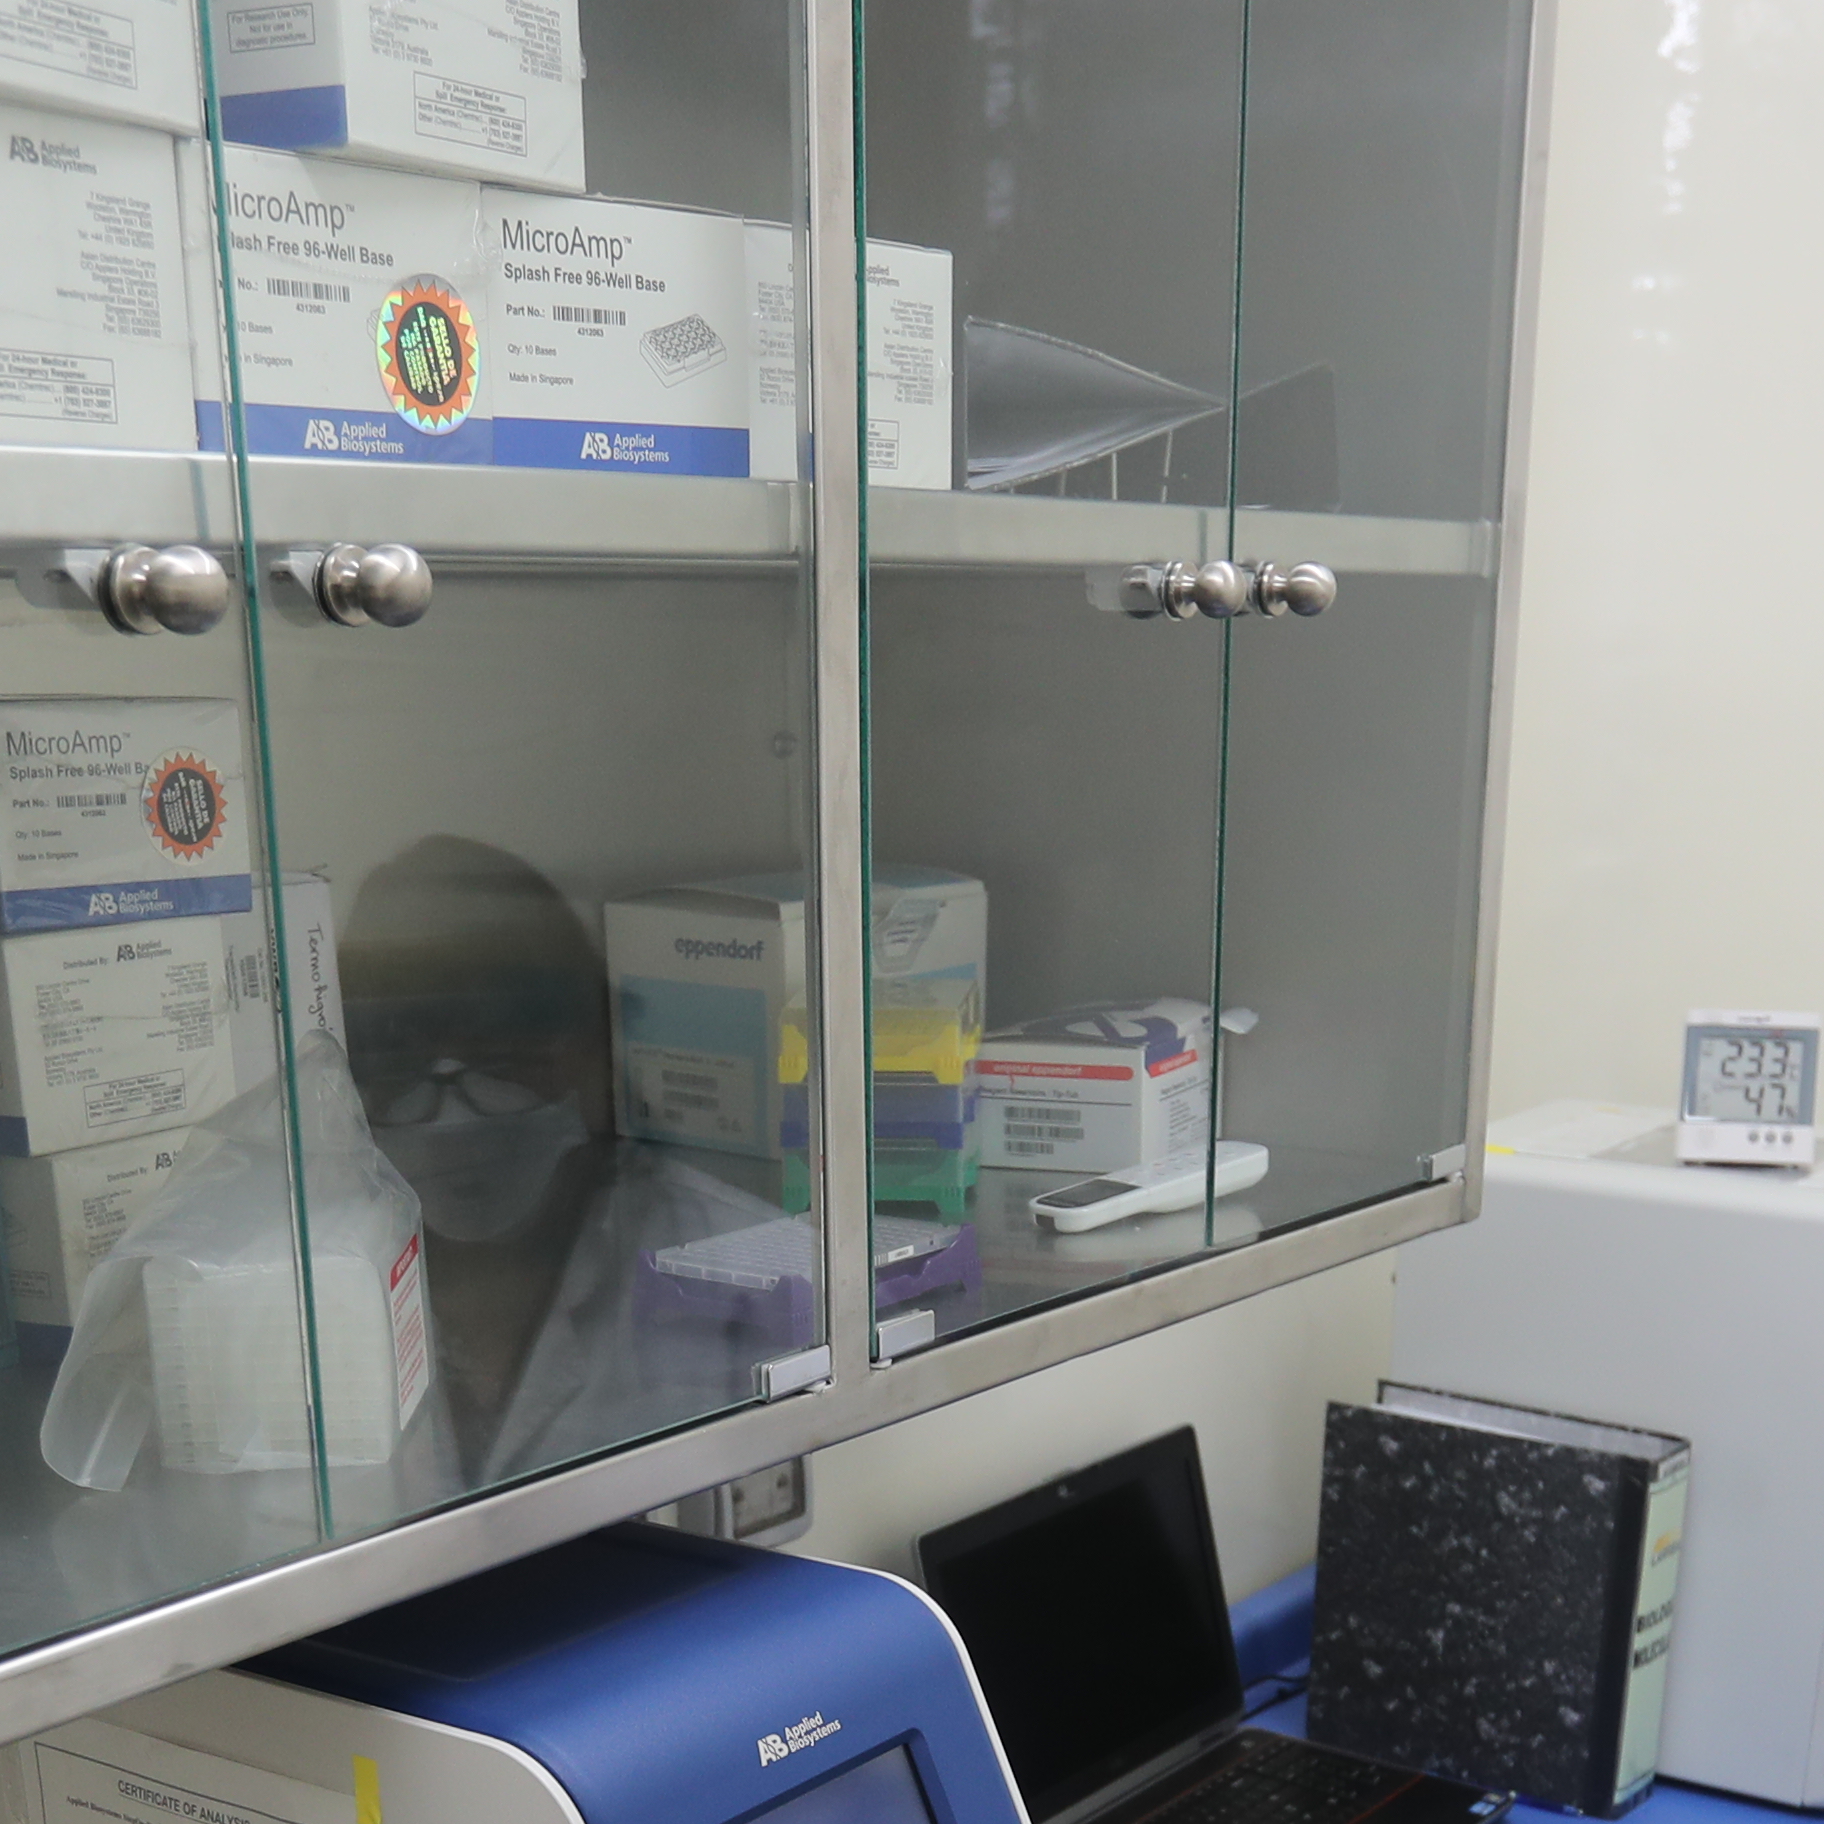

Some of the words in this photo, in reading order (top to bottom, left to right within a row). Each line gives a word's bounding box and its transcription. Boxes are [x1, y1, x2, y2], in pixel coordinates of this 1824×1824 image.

[40, 139, 81, 159] Applied
[267, 234, 300, 256] Free
[303, 240, 356, 263] 96-Well
[359, 245, 394, 268] Base
[504, 262, 551, 283] Splash
[554, 266, 583, 286] Free
[585, 269, 633, 290] 96-Well
[635, 274, 666, 293] Base
[506, 304, 526, 317] Part
[527, 305, 546, 318] No.:
[248, 323, 273, 335] Bases
[524, 344, 534, 355] 10
[534, 345, 557, 357] Bases
[253, 353, 294, 368] Singapore
[509, 371, 529, 384] Made
[530, 372, 538, 383] in
[539, 373, 574, 387] Singapore
[304, 419, 339, 451] AB
[340, 420, 387, 440] Applied
[340, 437, 405, 455] Biosystems
[580, 431, 613, 460] AB
[613, 433, 655, 451] Applied
[613, 446, 670, 464] Biosystems
[9, 765, 53, 782] Splash
[57, 765, 85, 778] Free
[87, 762, 131, 777] 96-Well
[12, 799, 31, 809] Part
[41, 829, 62, 838] Bases
[17, 853, 36, 861] Made
[45, 850, 79, 861] Singapore
[88, 892, 120, 917] AB
[119, 888, 159, 903] Applied
[119, 899, 175, 914] Biosystems
[62, 957, 98, 970] Distributed
[116, 943, 136, 962] AB
[136, 940, 162, 951] Applied
[136, 947, 173, 961] Biosystems
[674, 937, 765, 962] eppendorf
[756, 1732, 790, 1768] AB
[784, 1710, 824, 1741] Applied
[787, 1718, 843, 1754] Biosystems
[117, 1779, 181, 1813] CERTIFICATE
[183, 1800, 198, 1817] OF
